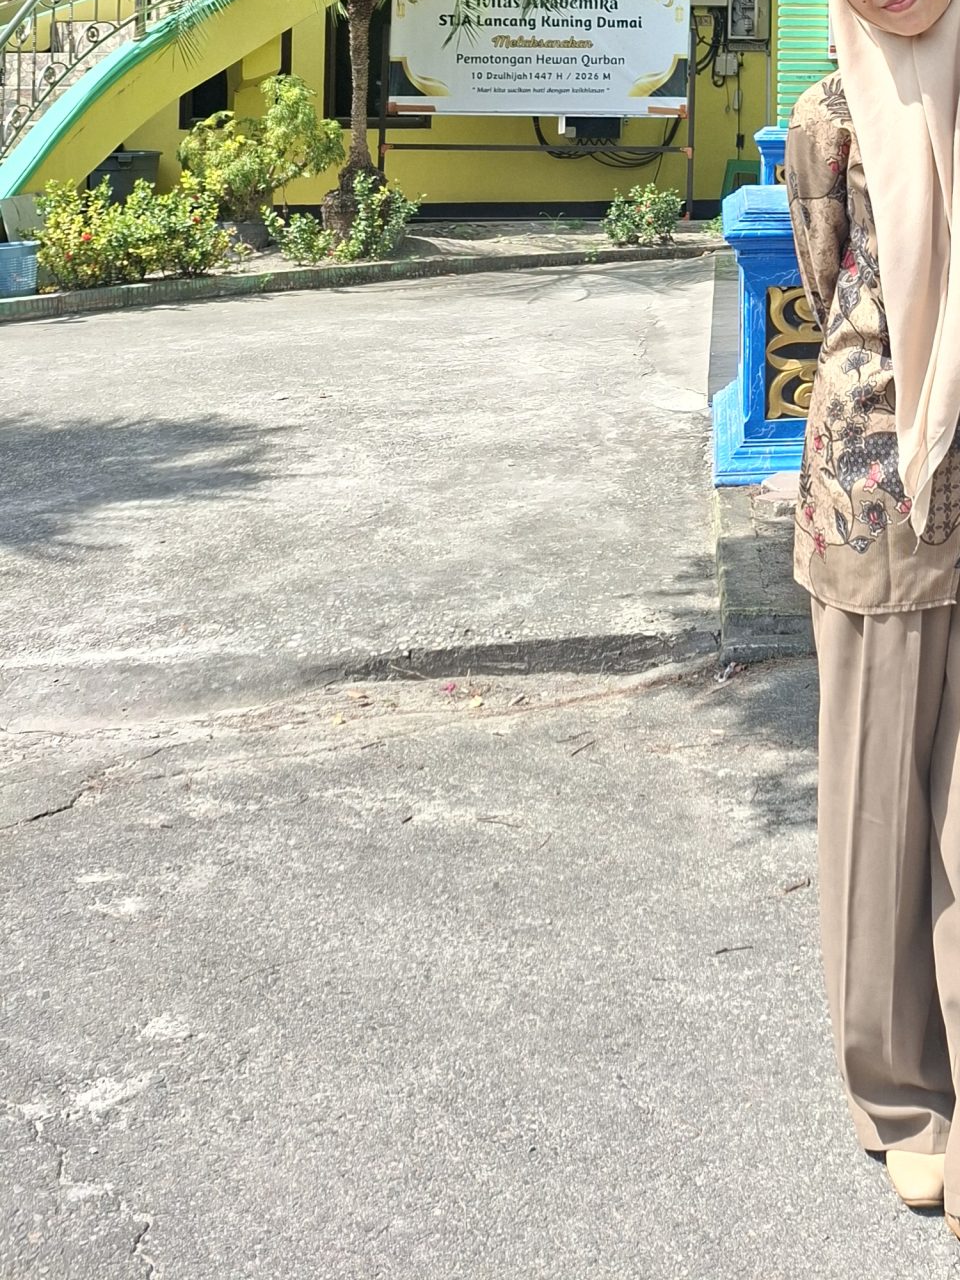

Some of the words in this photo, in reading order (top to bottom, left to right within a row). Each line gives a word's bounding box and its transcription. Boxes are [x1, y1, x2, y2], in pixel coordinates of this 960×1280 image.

[477, 15, 536, 30] Lancang
[541, 16, 592, 31] Kuning
[597, 16, 642, 28] Dumai
[491, 35, 594, 49] Melaksanakan
[456, 54, 532, 67] Pemotongan
[536, 54, 577, 65] Hewan
[581, 54, 625, 67] Qurban
[471, 72, 483, 80] 10
[556, 72, 563, 80] H
[575, 72, 599, 80] 2026
[603, 72, 611, 80] M
